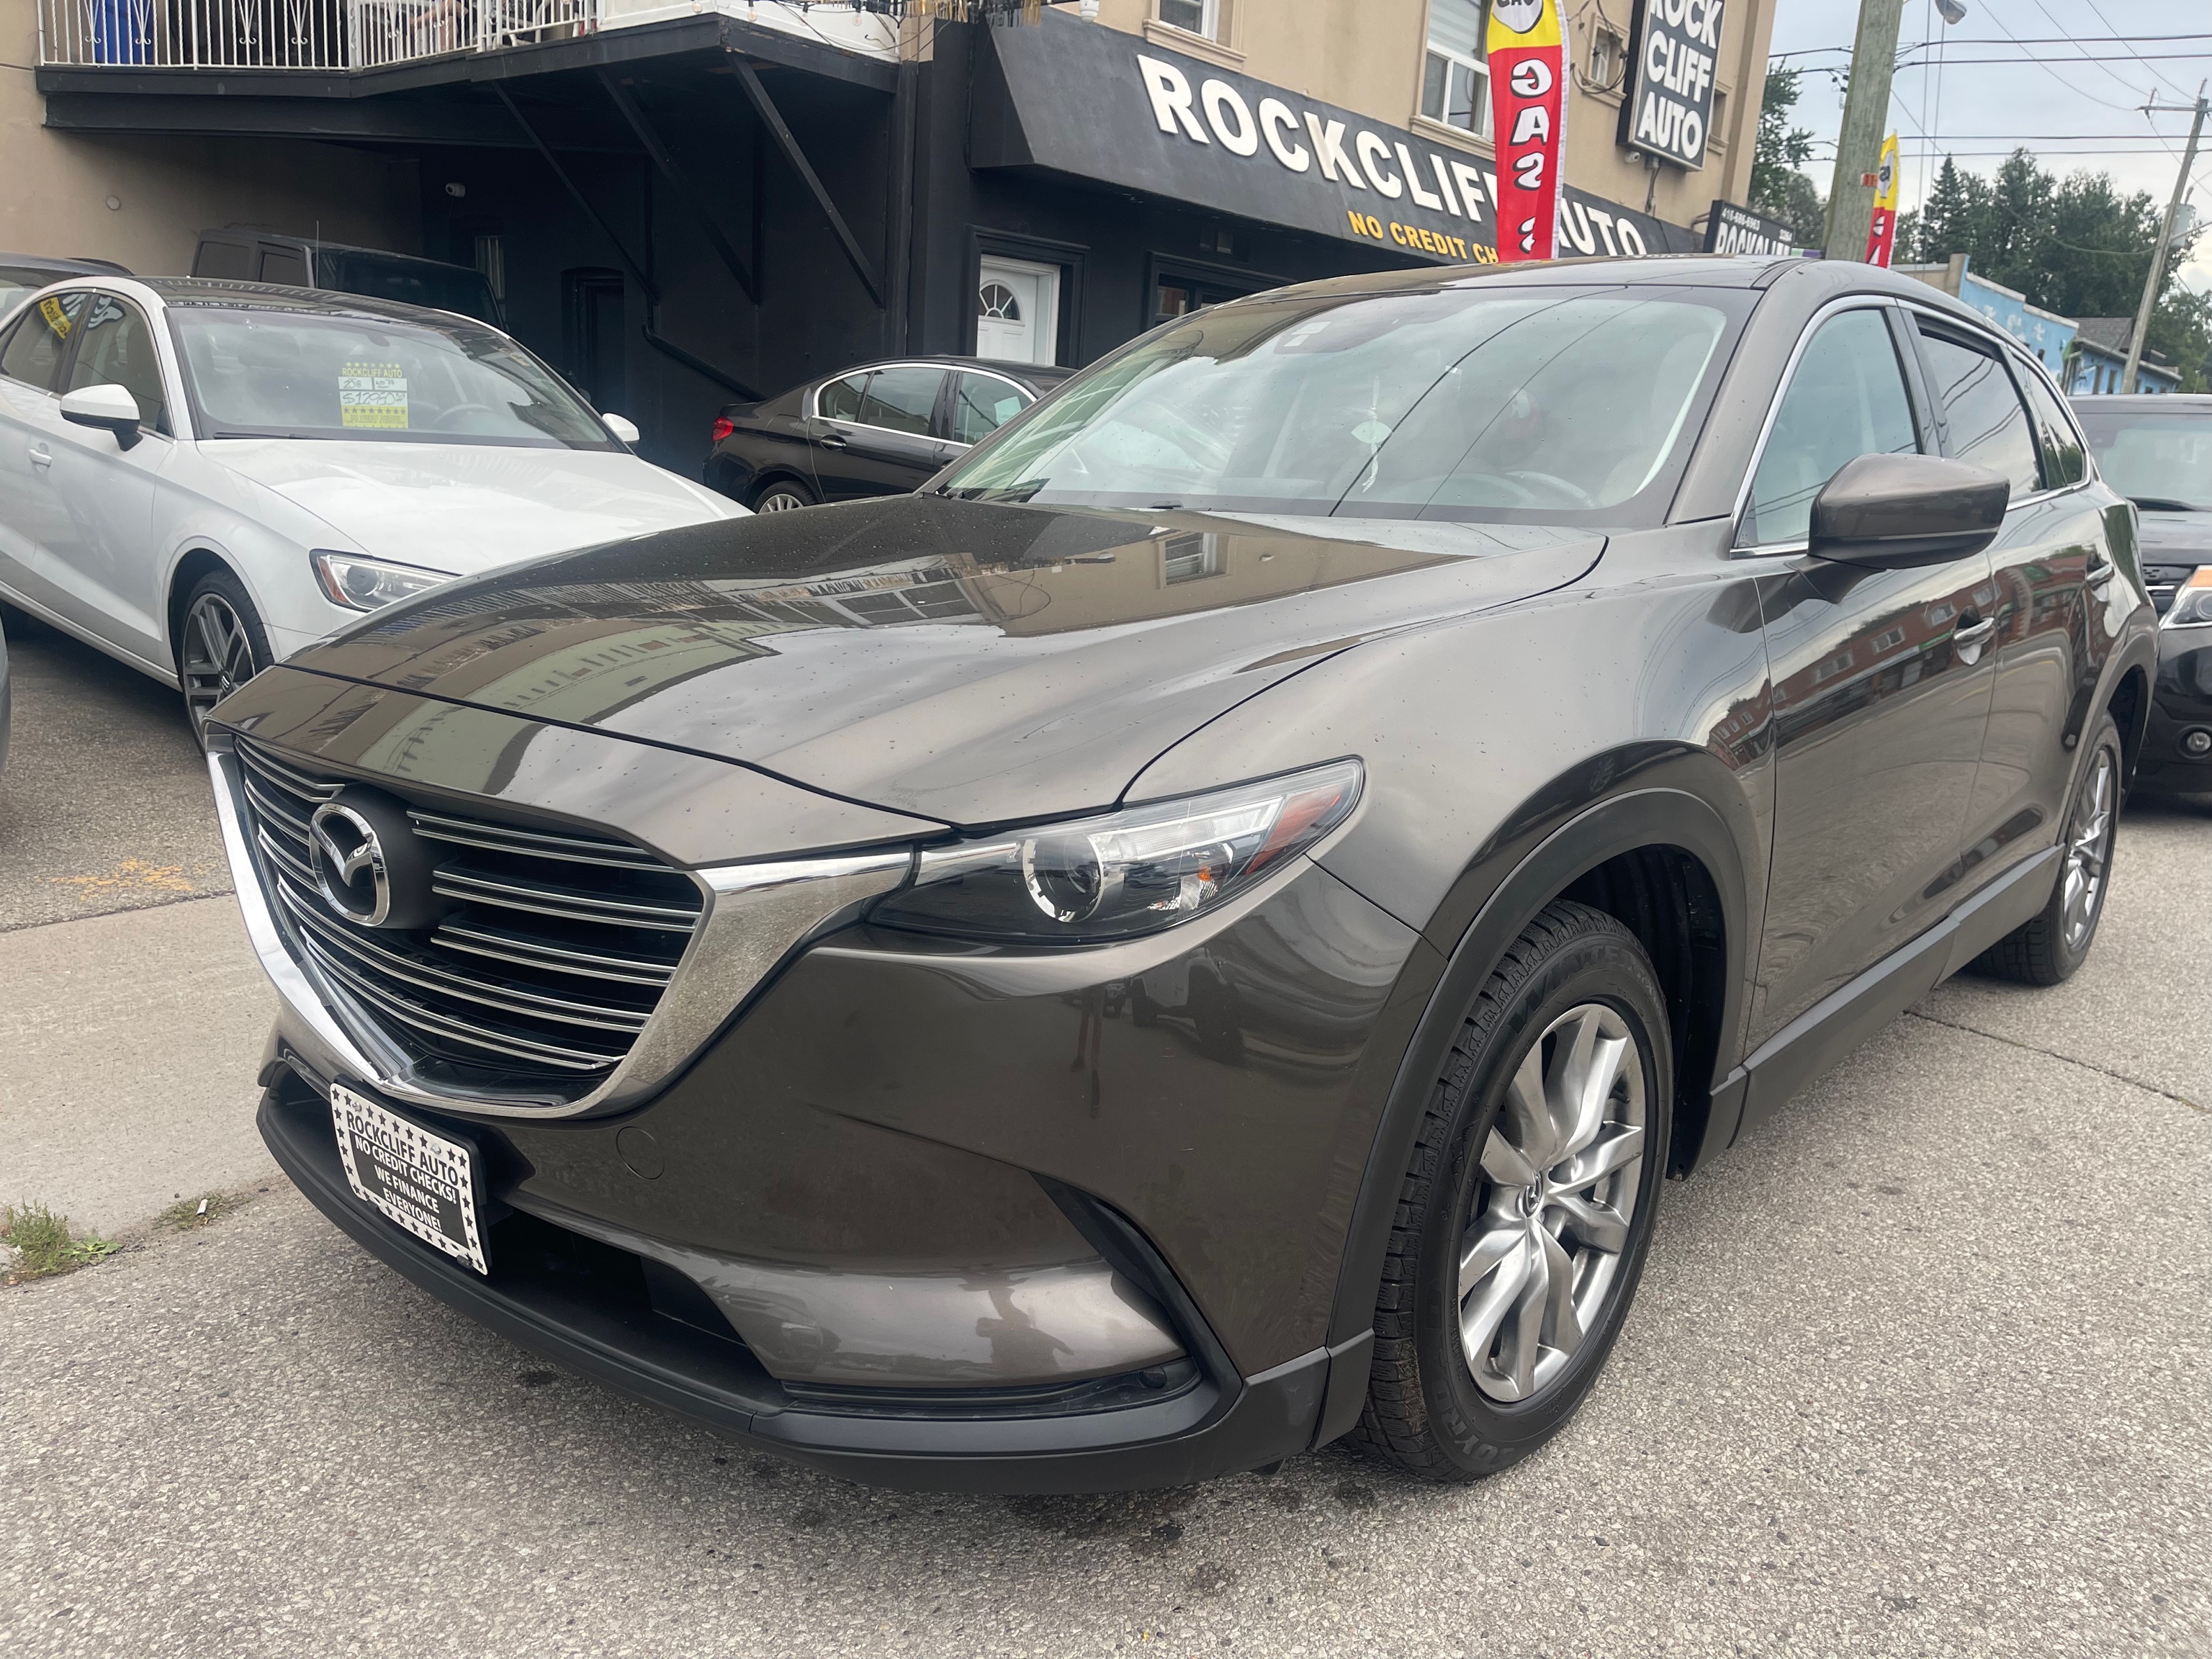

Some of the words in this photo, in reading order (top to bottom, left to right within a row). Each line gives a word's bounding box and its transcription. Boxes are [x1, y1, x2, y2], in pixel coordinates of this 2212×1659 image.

[1646, 30, 1713, 104] CLIFF
[1637, 91, 1703, 159] AUTO
[1347, 210, 1383, 240] NO
[1389, 222, 1467, 260] CREDIT
[342, 367, 382, 377] ROCKCLIFF
[383, 369, 403, 378] AUTO
[346, 1110, 415, 1163] ROCKCLIFF
[420, 1151, 458, 1186] AUTO
[355, 1135, 370, 1155] NO
[372, 1145, 408, 1177] CREDIT
[410, 1166, 457, 1205] CHECKS!
[374, 1164, 392, 1187] WE
[393, 1176, 440, 1214] FINANCE
[382, 1187, 443, 1233] EVERYONE!
